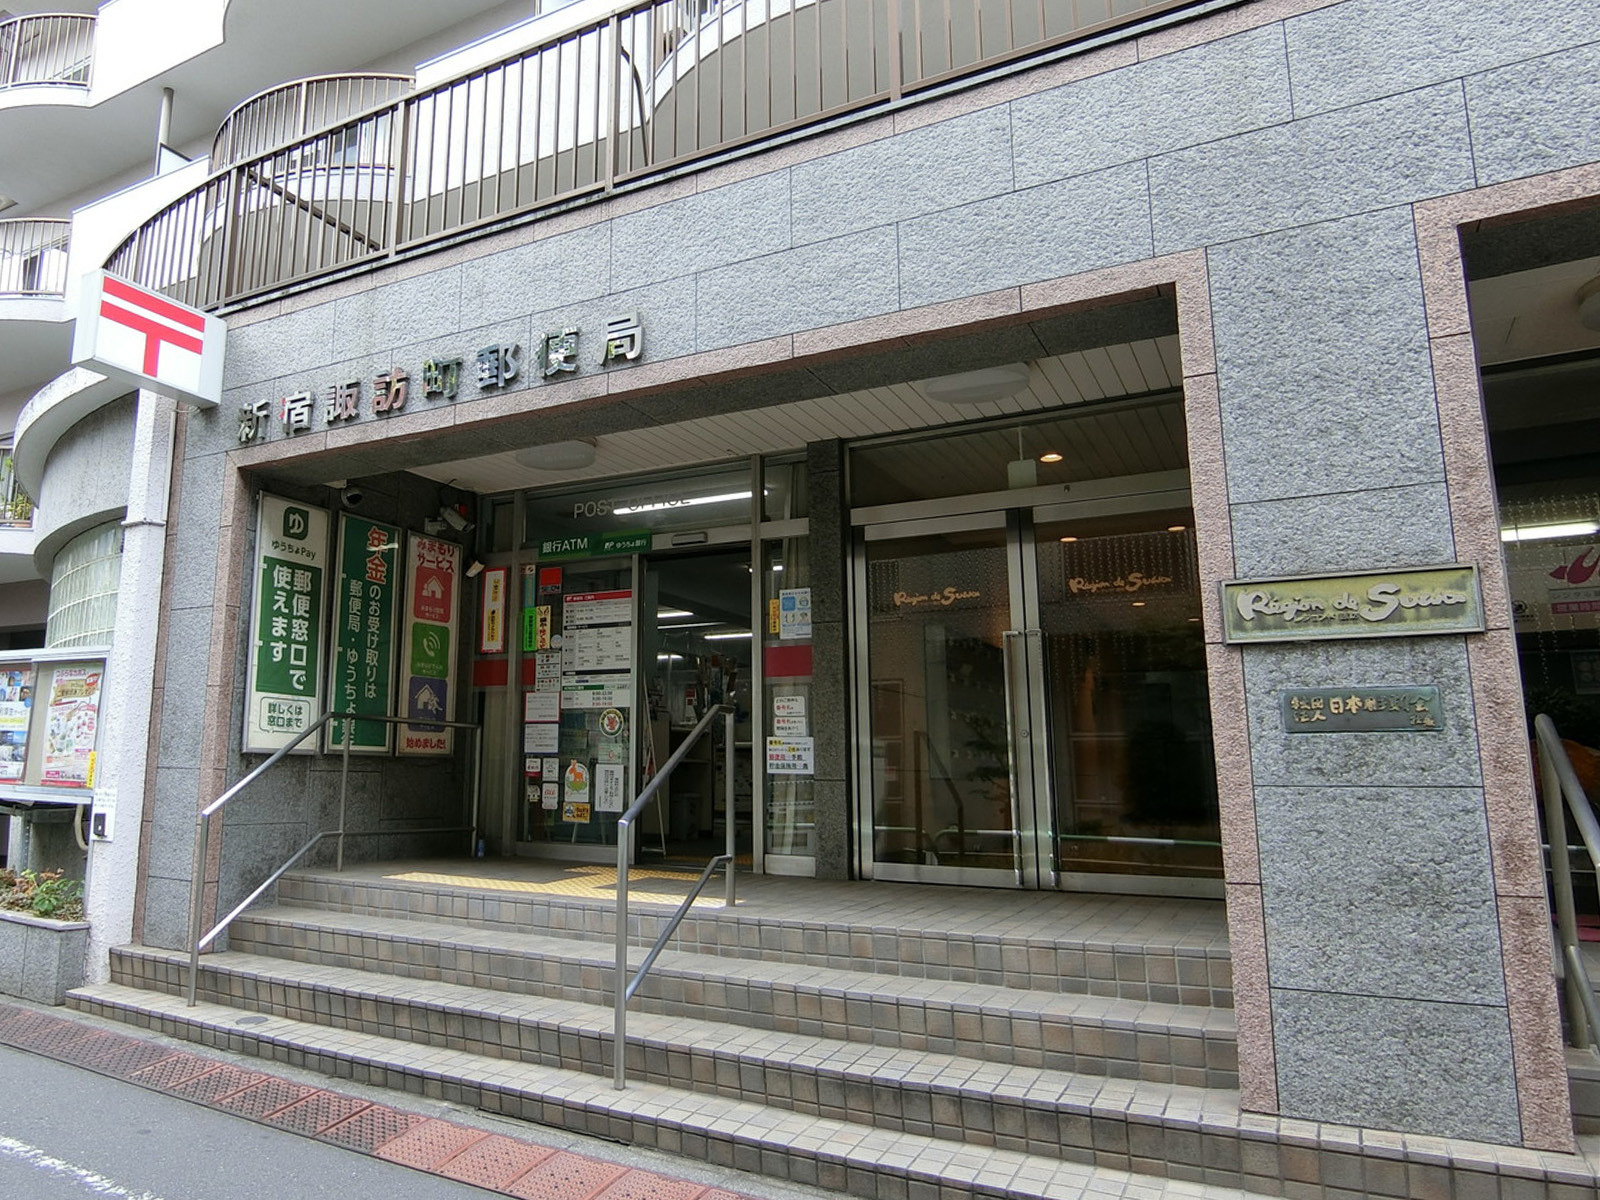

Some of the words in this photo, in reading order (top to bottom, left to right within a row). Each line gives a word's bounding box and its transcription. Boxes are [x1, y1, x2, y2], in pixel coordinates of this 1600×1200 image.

[238, 311, 644, 444] 新宿諏訪町郵便局
[573, 498, 617, 519] POST
[272, 540, 316, 560] ゆうちょPay
[417, 539, 455, 557] みまもり
[542, 537, 588, 554] 銀行ATM
[417, 552, 455, 573] サービス
[1113, 577, 1125, 587] de
[930, 592, 941, 600] de
[1333, 592, 1359, 611] de
[271, 563, 292, 662] 使えます
[289, 569, 312, 691] 郵便窓口で
[268, 702, 303, 716] 詳しくは
[267, 715, 303, 728] 窓口まで
